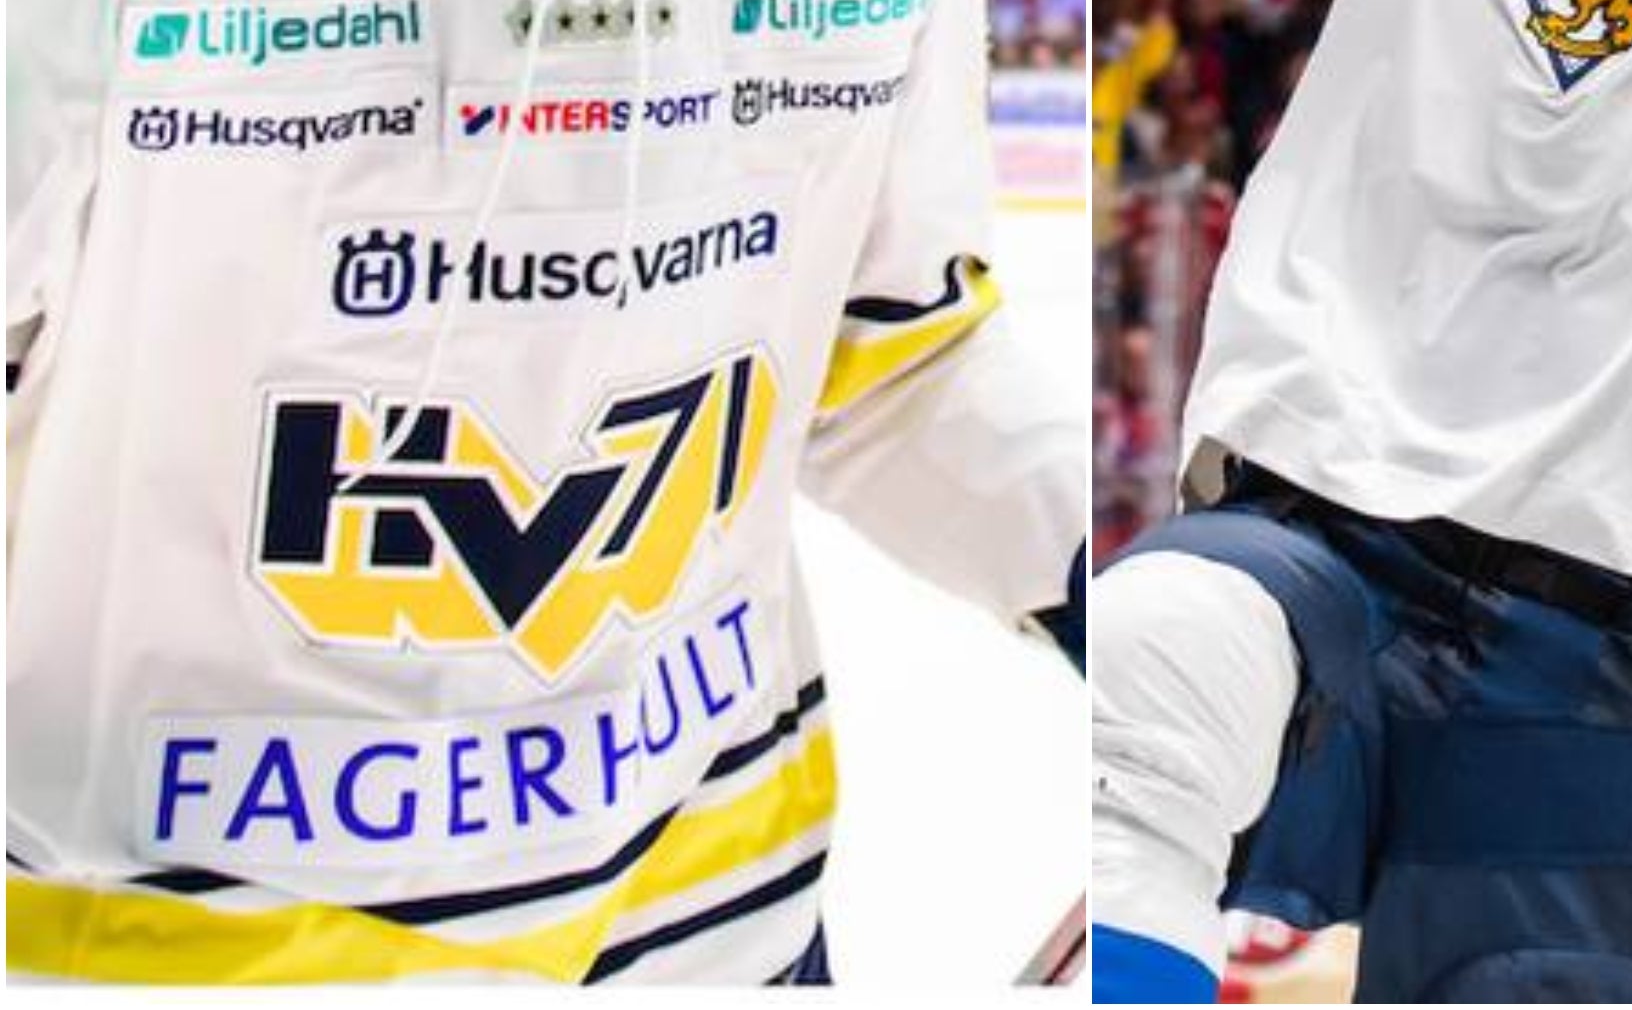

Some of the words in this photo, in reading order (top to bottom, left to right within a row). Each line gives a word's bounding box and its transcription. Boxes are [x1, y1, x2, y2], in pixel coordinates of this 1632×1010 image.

[184, 102, 416, 152] Husqvarna
[426, 210, 779, 310] Husqvarna
[154, 600, 756, 843] FAGERHULT
